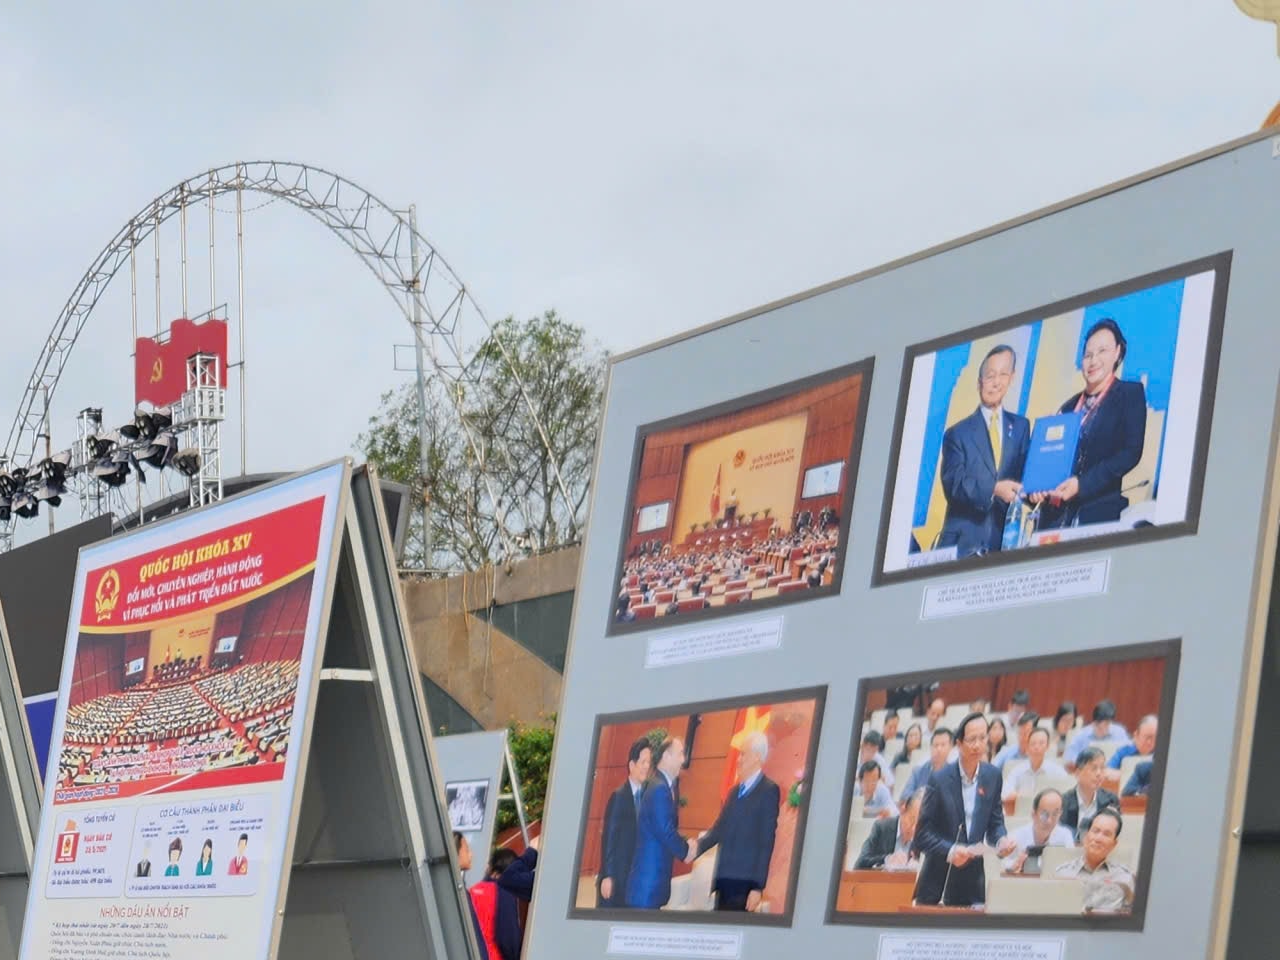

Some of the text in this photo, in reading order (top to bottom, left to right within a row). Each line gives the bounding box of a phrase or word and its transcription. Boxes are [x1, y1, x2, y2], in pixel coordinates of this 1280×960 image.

[140, 533, 252, 583] QUỐC HỘI KHÓA XV
[157, 577, 186, 595] CHUYÊN
[216, 562, 238, 577] HÀNH
[238, 554, 262, 573] ĐỘNG
[130, 604, 150, 619] PHỤC
[150, 600, 163, 614] HỒI
[165, 597, 175, 610] VÀ
[176, 591, 196, 607] PHÁT
[199, 583, 220, 603] TRIỂN
[221, 580, 238, 595] ĐẤT
[239, 573, 262, 589] NƯỚC
[100, 903, 190, 919] NHỮNG DẤU ẤN NỔI BẬT
